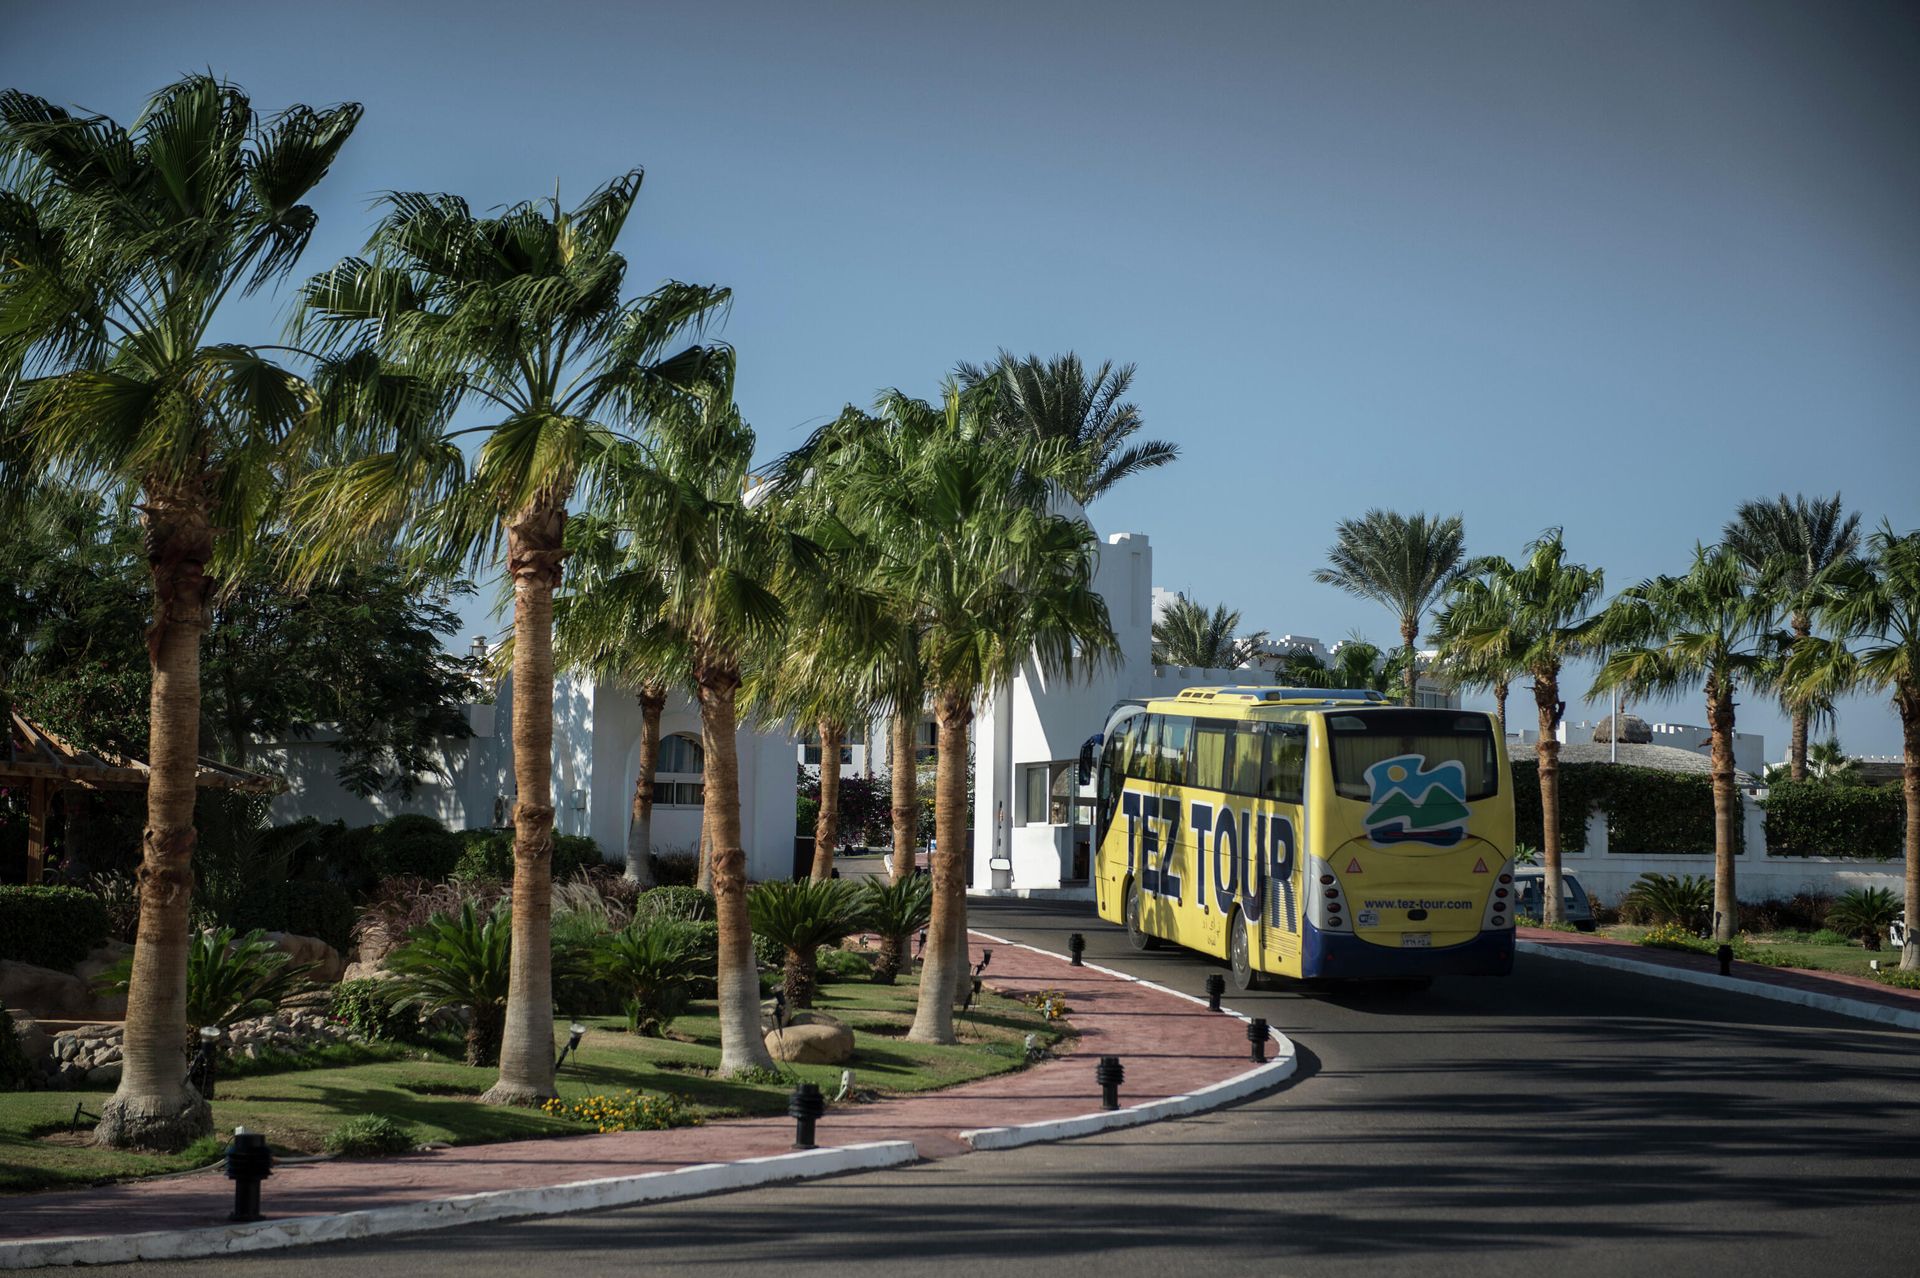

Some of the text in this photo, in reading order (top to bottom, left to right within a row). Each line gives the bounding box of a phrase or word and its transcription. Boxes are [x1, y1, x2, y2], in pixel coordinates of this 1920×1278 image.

[1122, 790, 1297, 933] TEZ TOUR
[1364, 899, 1473, 910] www.tez-tour.com
